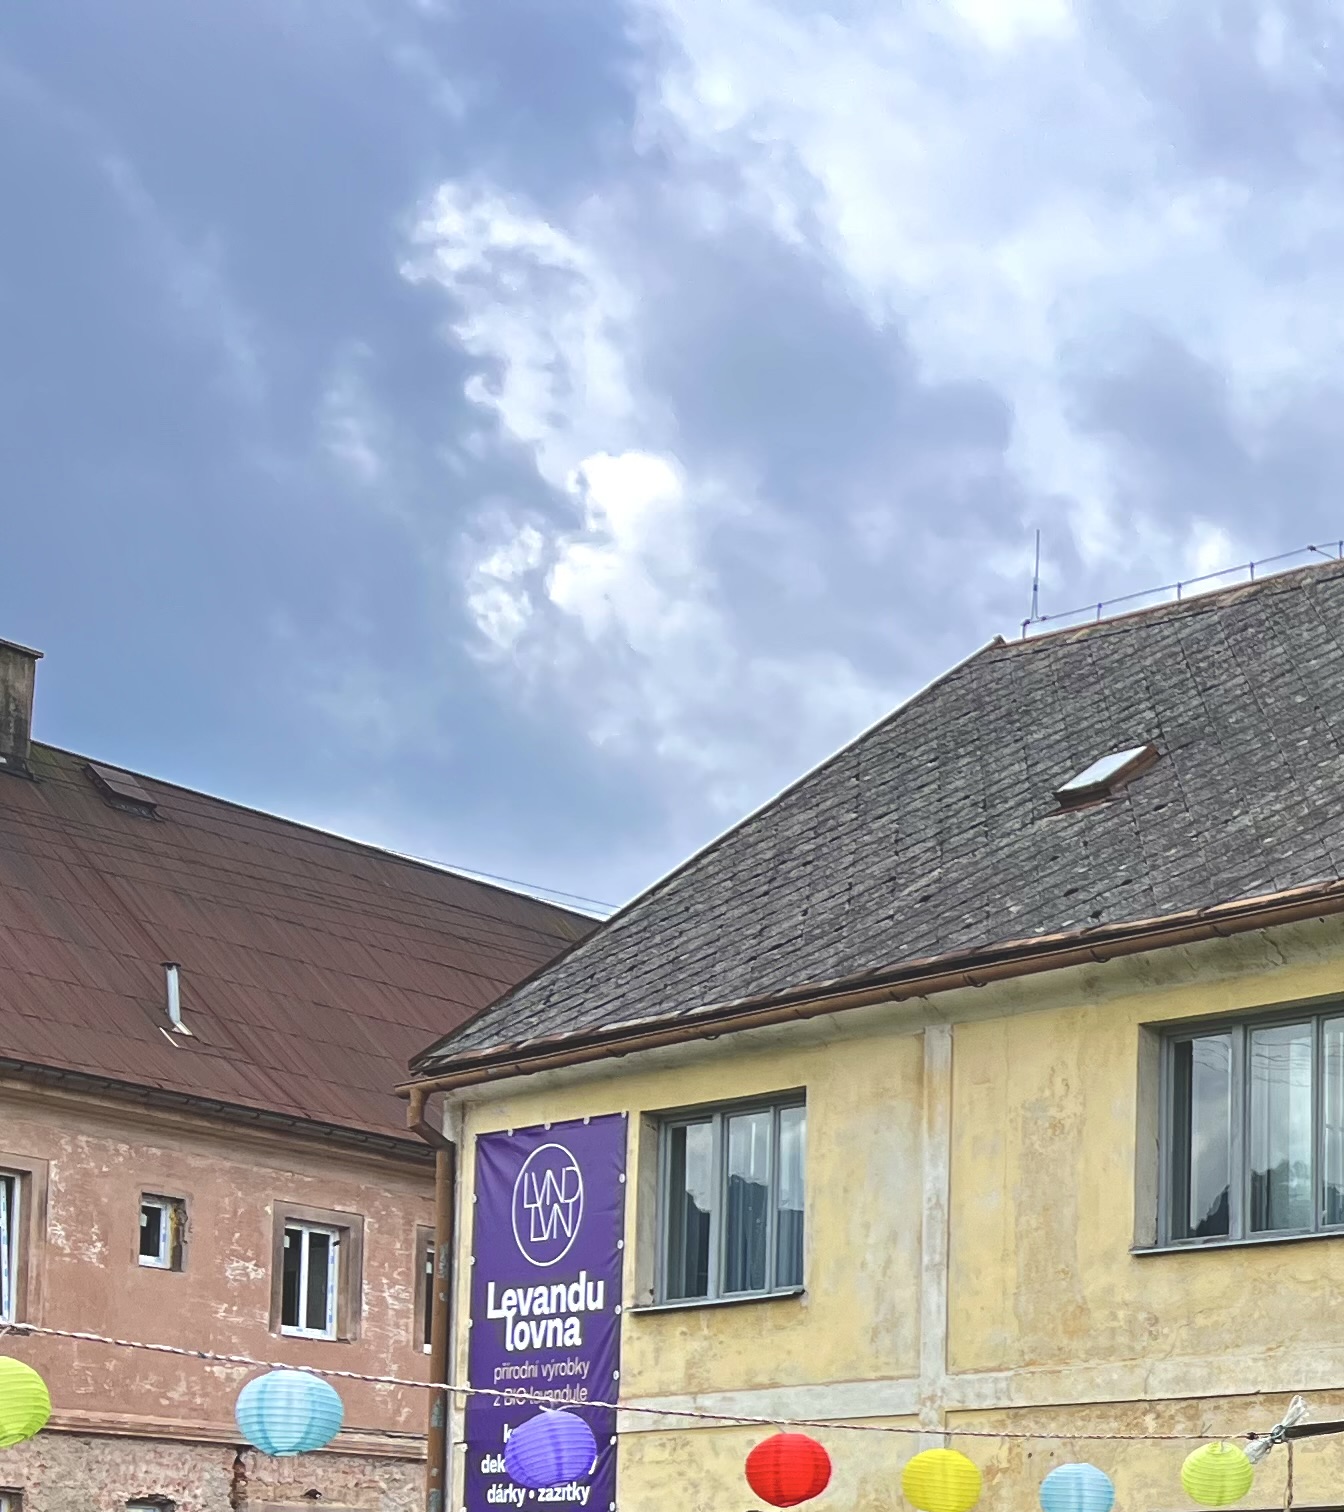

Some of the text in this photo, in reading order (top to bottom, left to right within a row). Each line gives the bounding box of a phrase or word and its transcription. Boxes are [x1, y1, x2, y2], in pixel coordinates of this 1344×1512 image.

[487, 1271, 604, 1319] Levandu
[505, 1309, 582, 1351] lovna
[494, 1357, 590, 1384] přírodní výrobky
[487, 1483, 526, 1507] dárky
